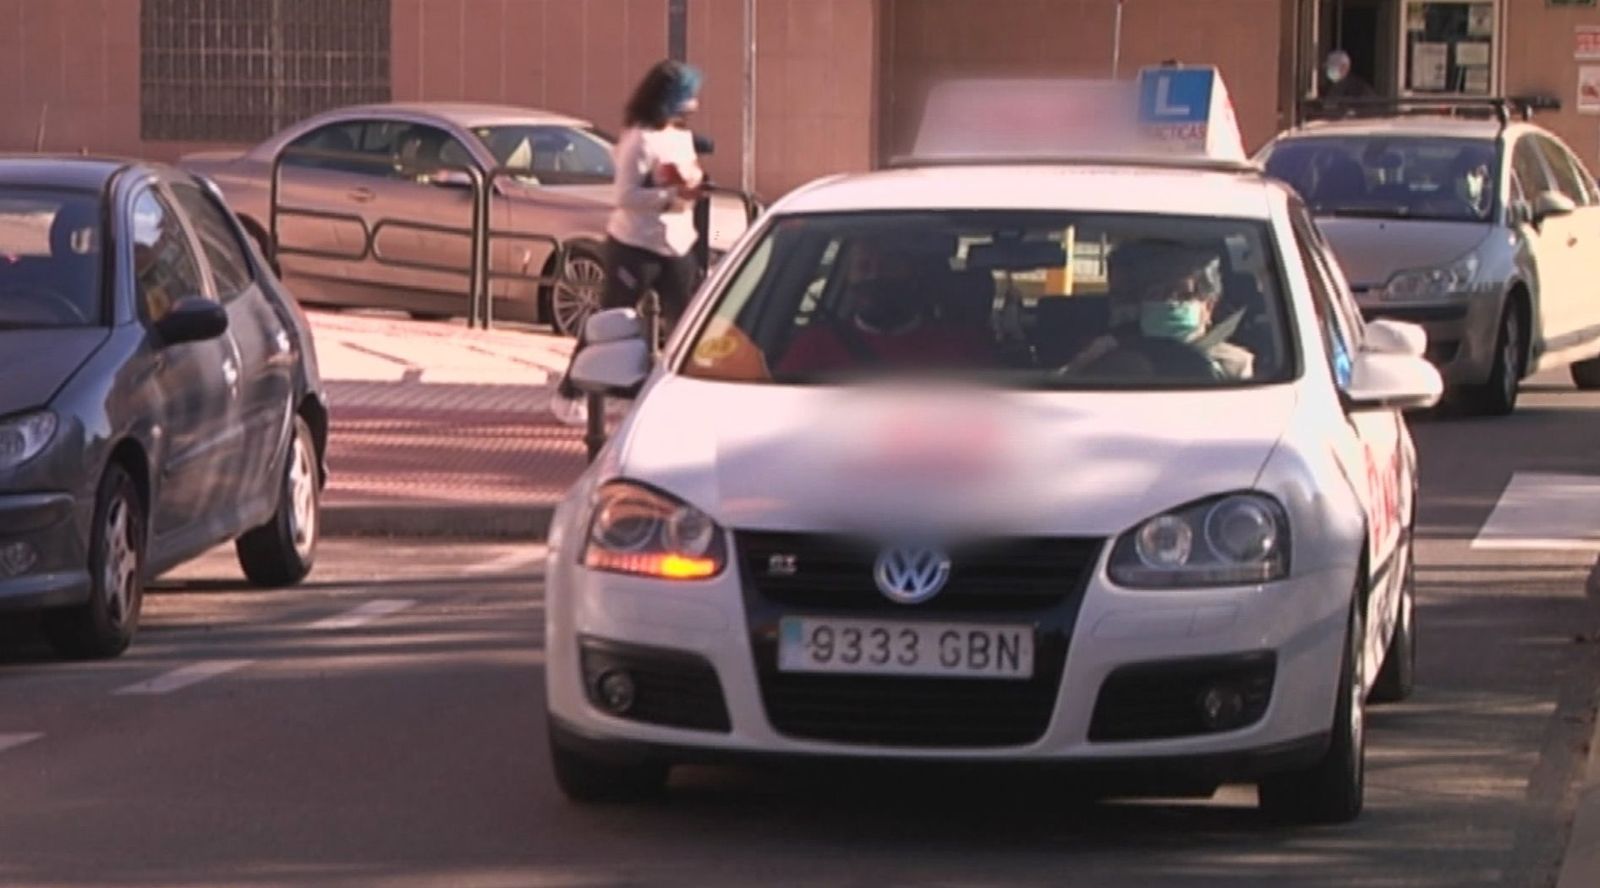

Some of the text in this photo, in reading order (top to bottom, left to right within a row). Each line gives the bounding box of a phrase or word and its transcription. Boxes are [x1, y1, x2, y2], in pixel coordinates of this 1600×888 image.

[1155, 76, 1191, 116] L
[811, 625, 1020, 670] 9333 GBN
